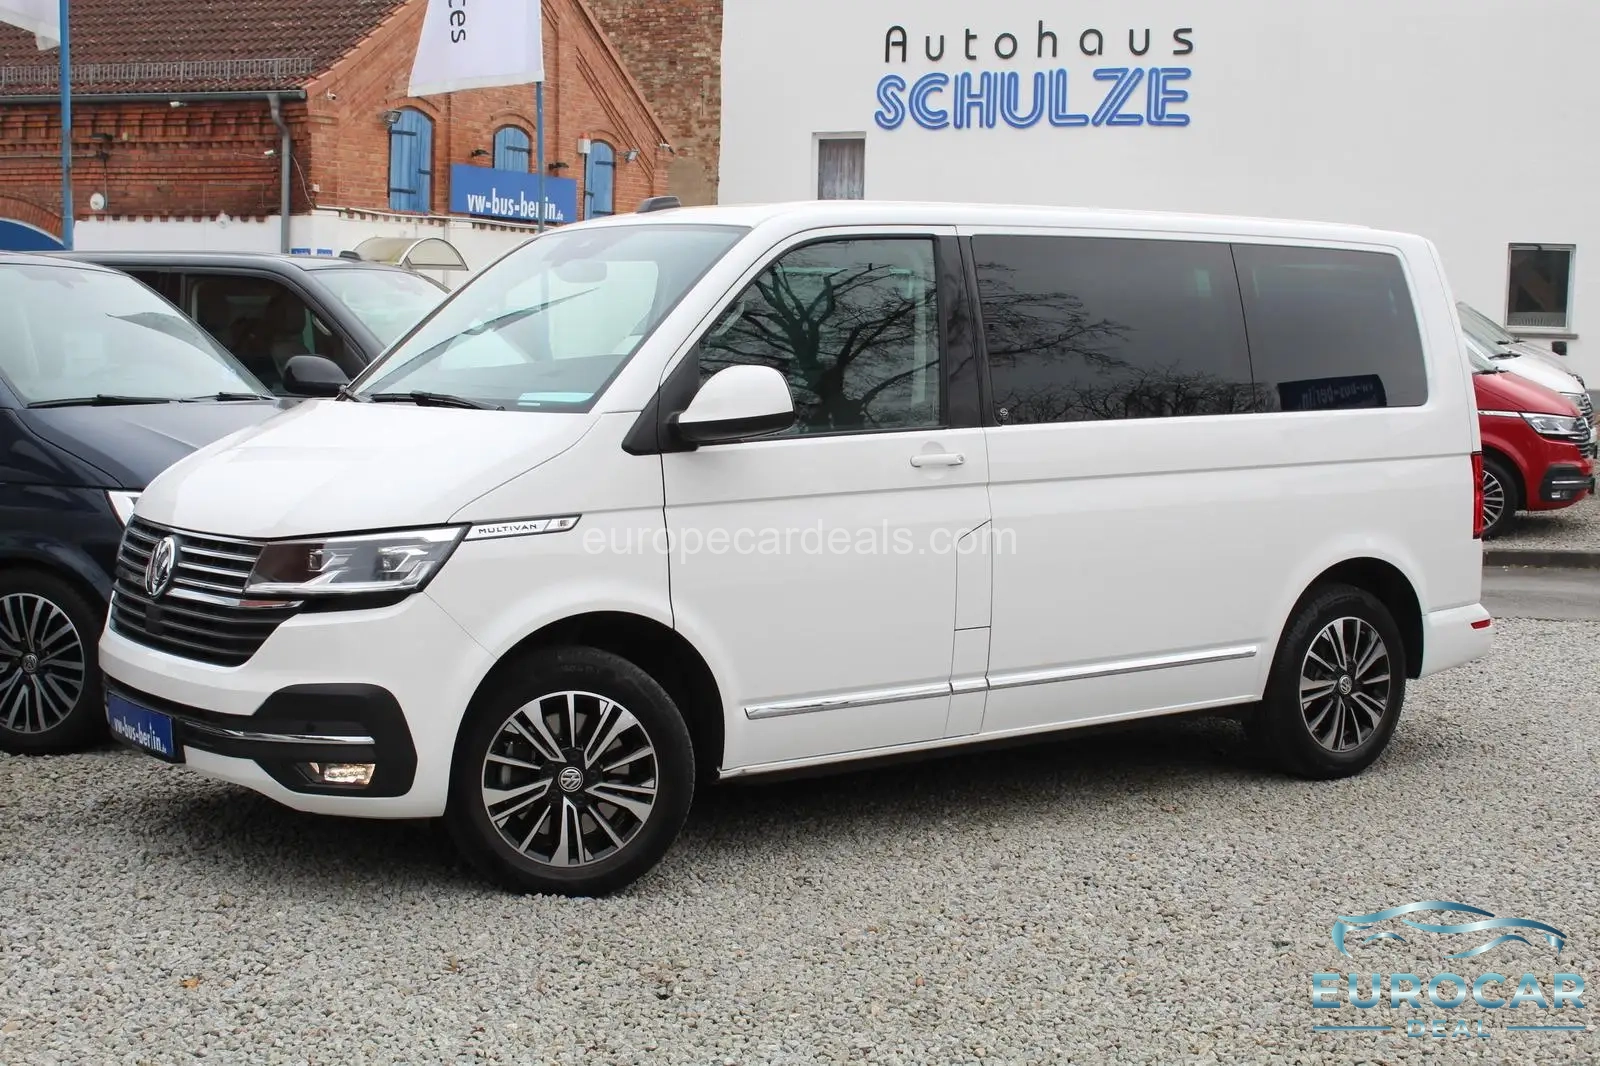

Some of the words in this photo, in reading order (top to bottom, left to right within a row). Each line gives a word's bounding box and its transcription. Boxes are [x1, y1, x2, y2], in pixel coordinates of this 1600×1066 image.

[885, 20, 1194, 63] Autohaus
[874, 67, 1192, 130] SCHULZE
[478, 523, 537, 534] MULTIVAN
